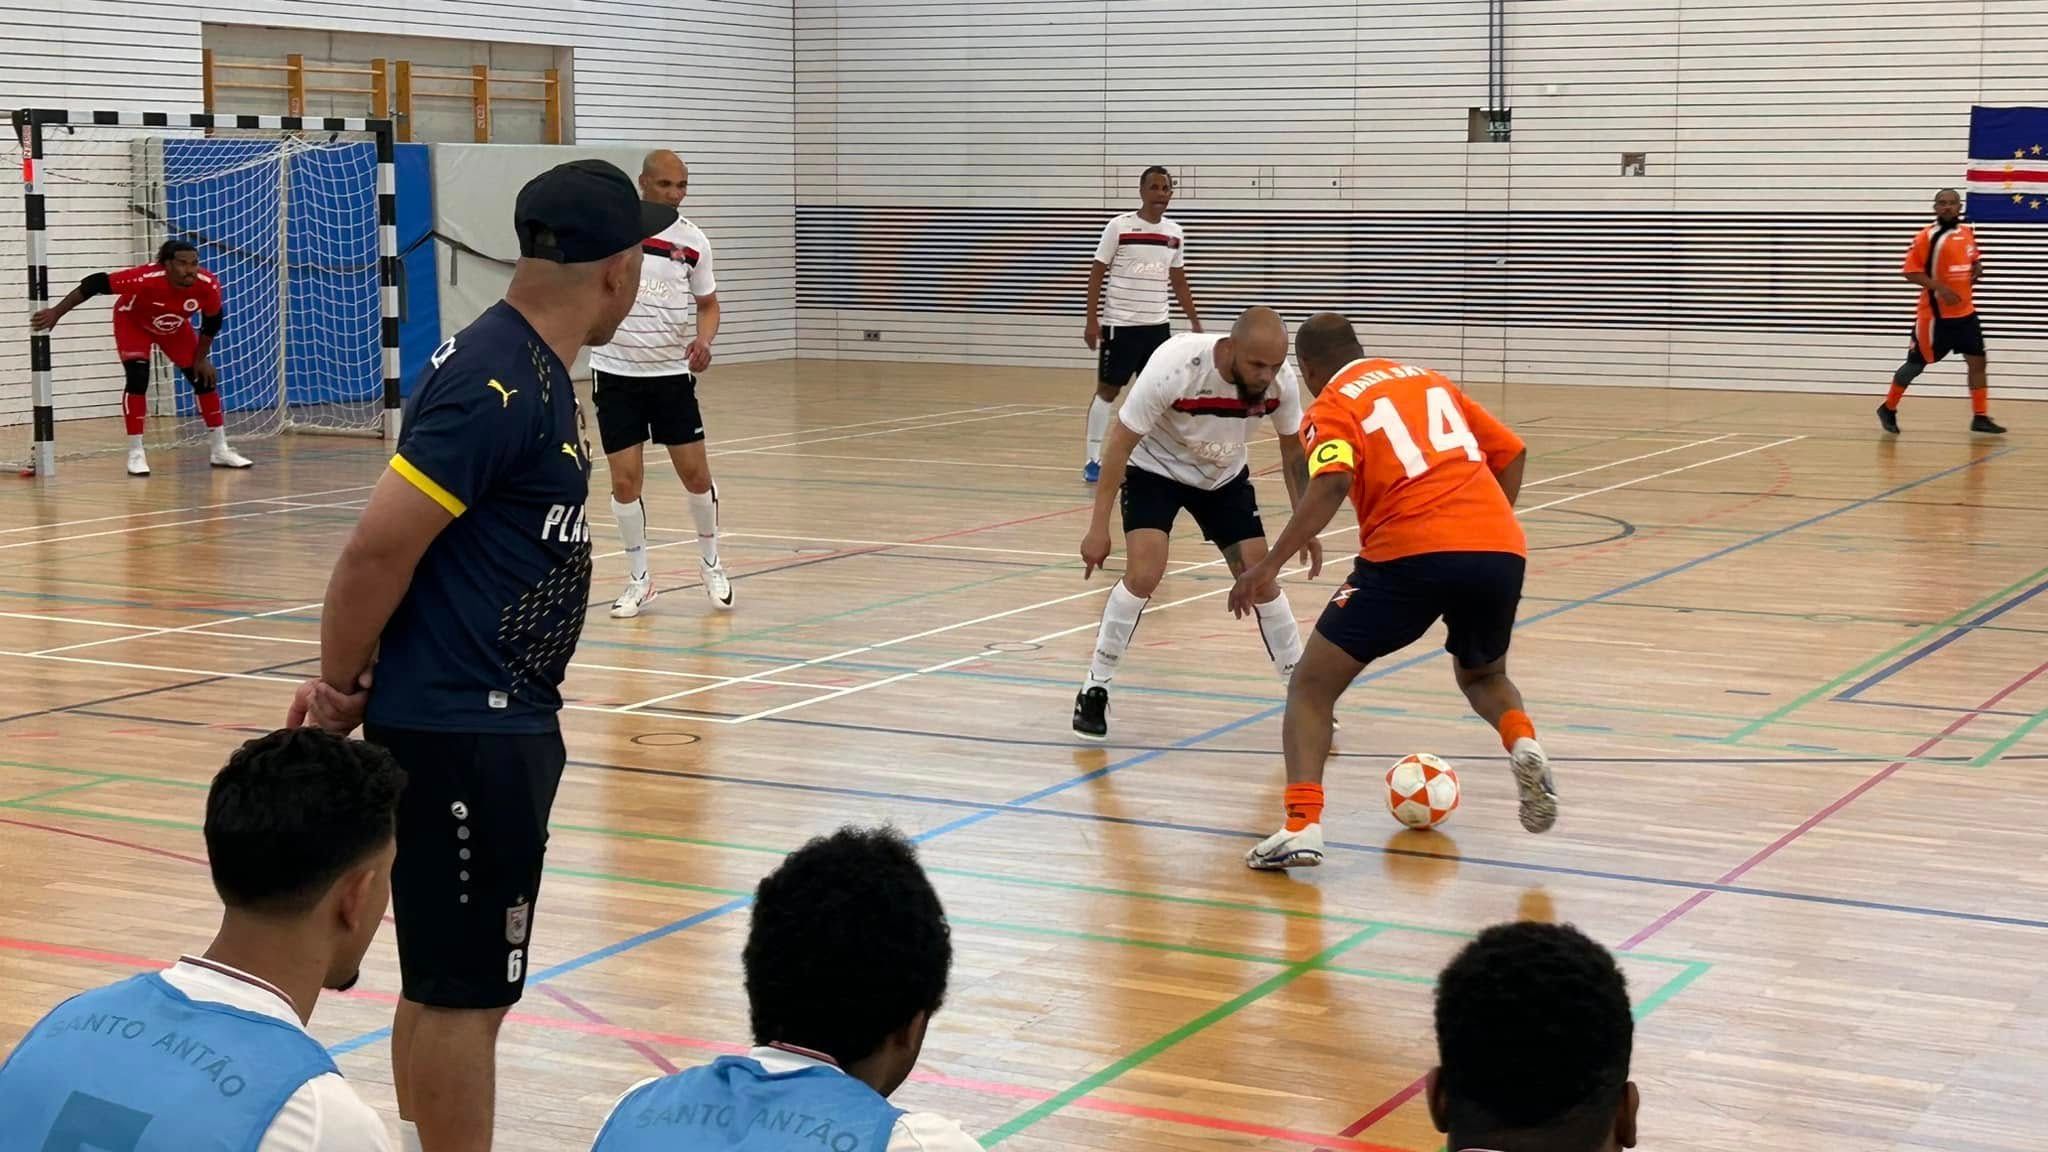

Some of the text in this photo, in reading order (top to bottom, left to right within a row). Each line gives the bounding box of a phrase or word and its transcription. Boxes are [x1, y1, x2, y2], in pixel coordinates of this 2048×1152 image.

[1317, 443, 1339, 464] C
[1360, 386, 1482, 480] 14
[507, 949, 523, 983] 6
[47, 1012, 246, 1098] SANTO ANTÃO
[748, 1103, 860, 1152] ANTÃO
